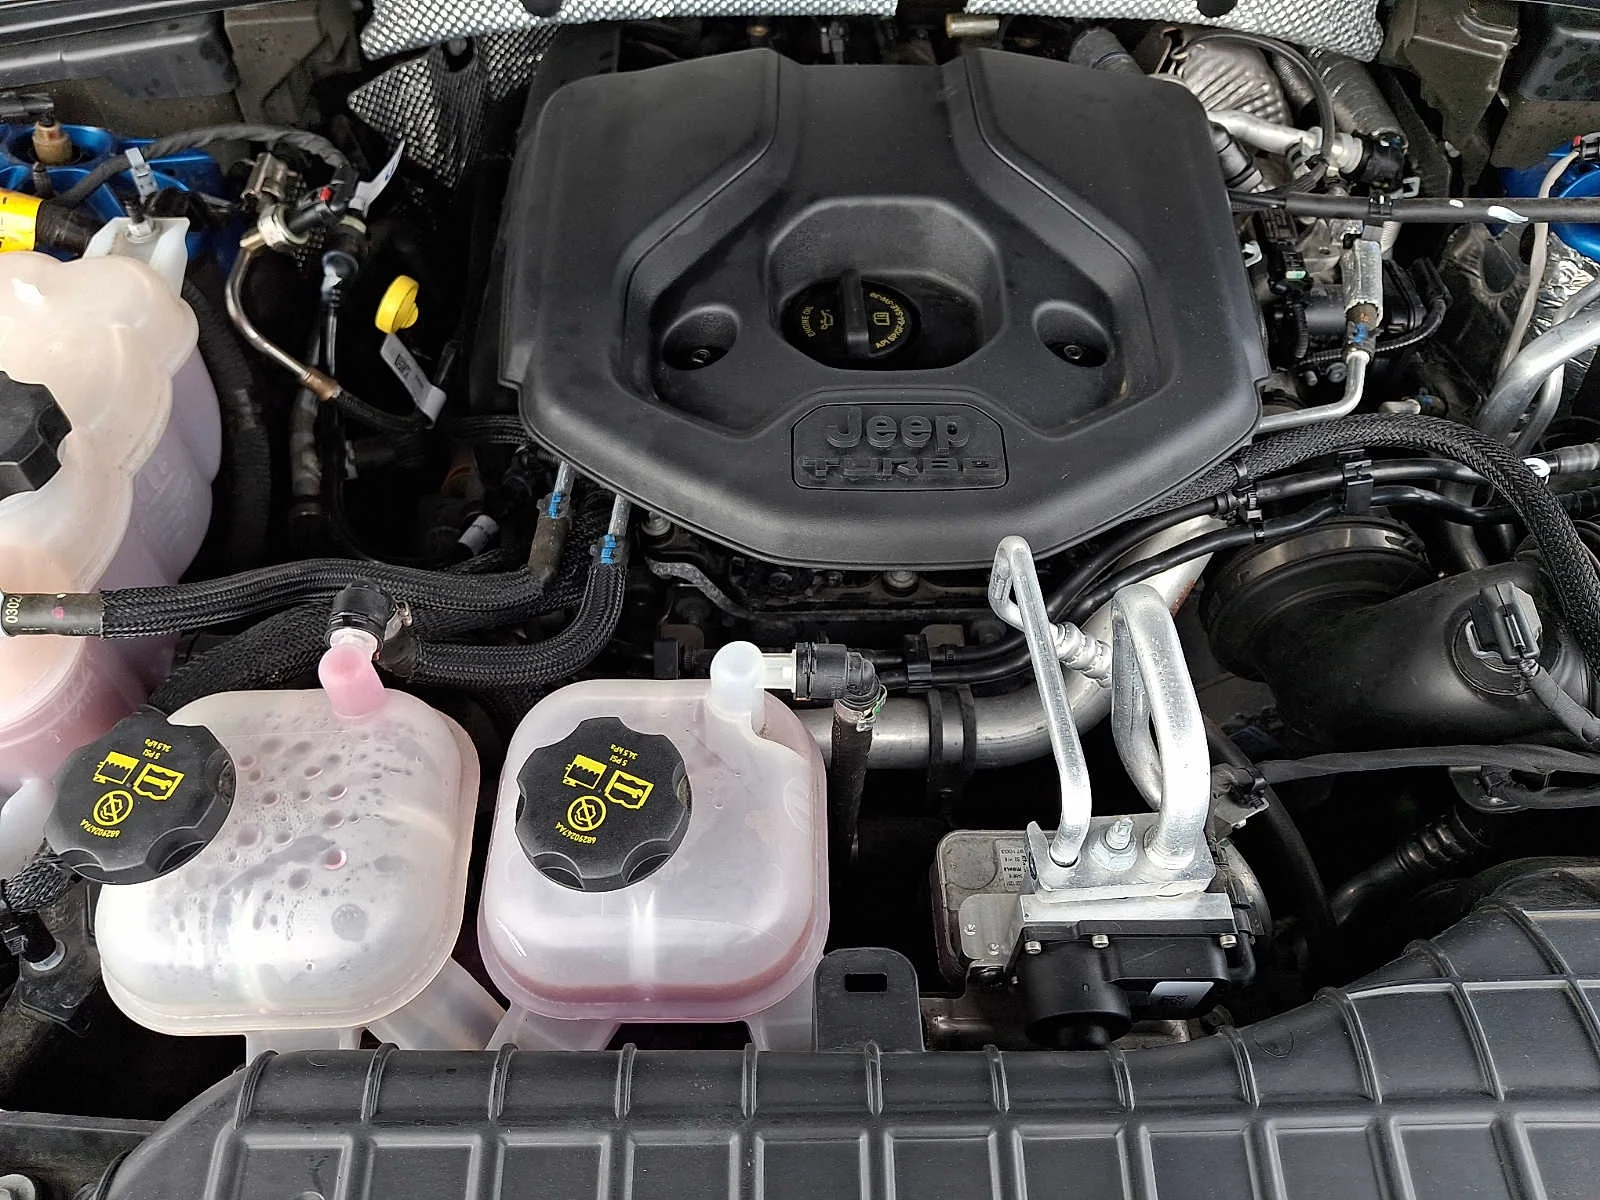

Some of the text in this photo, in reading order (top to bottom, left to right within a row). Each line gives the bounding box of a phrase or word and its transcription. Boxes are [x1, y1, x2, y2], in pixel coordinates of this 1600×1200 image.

[826, 406, 970, 455] Jeep
[799, 456, 1000, 482] TURBO
[5, 595, 23, 624] 0302
[142, 748, 161, 760] 5 PSI
[610, 743, 623, 754] kPa
[609, 755, 628, 767] 5 PSI
